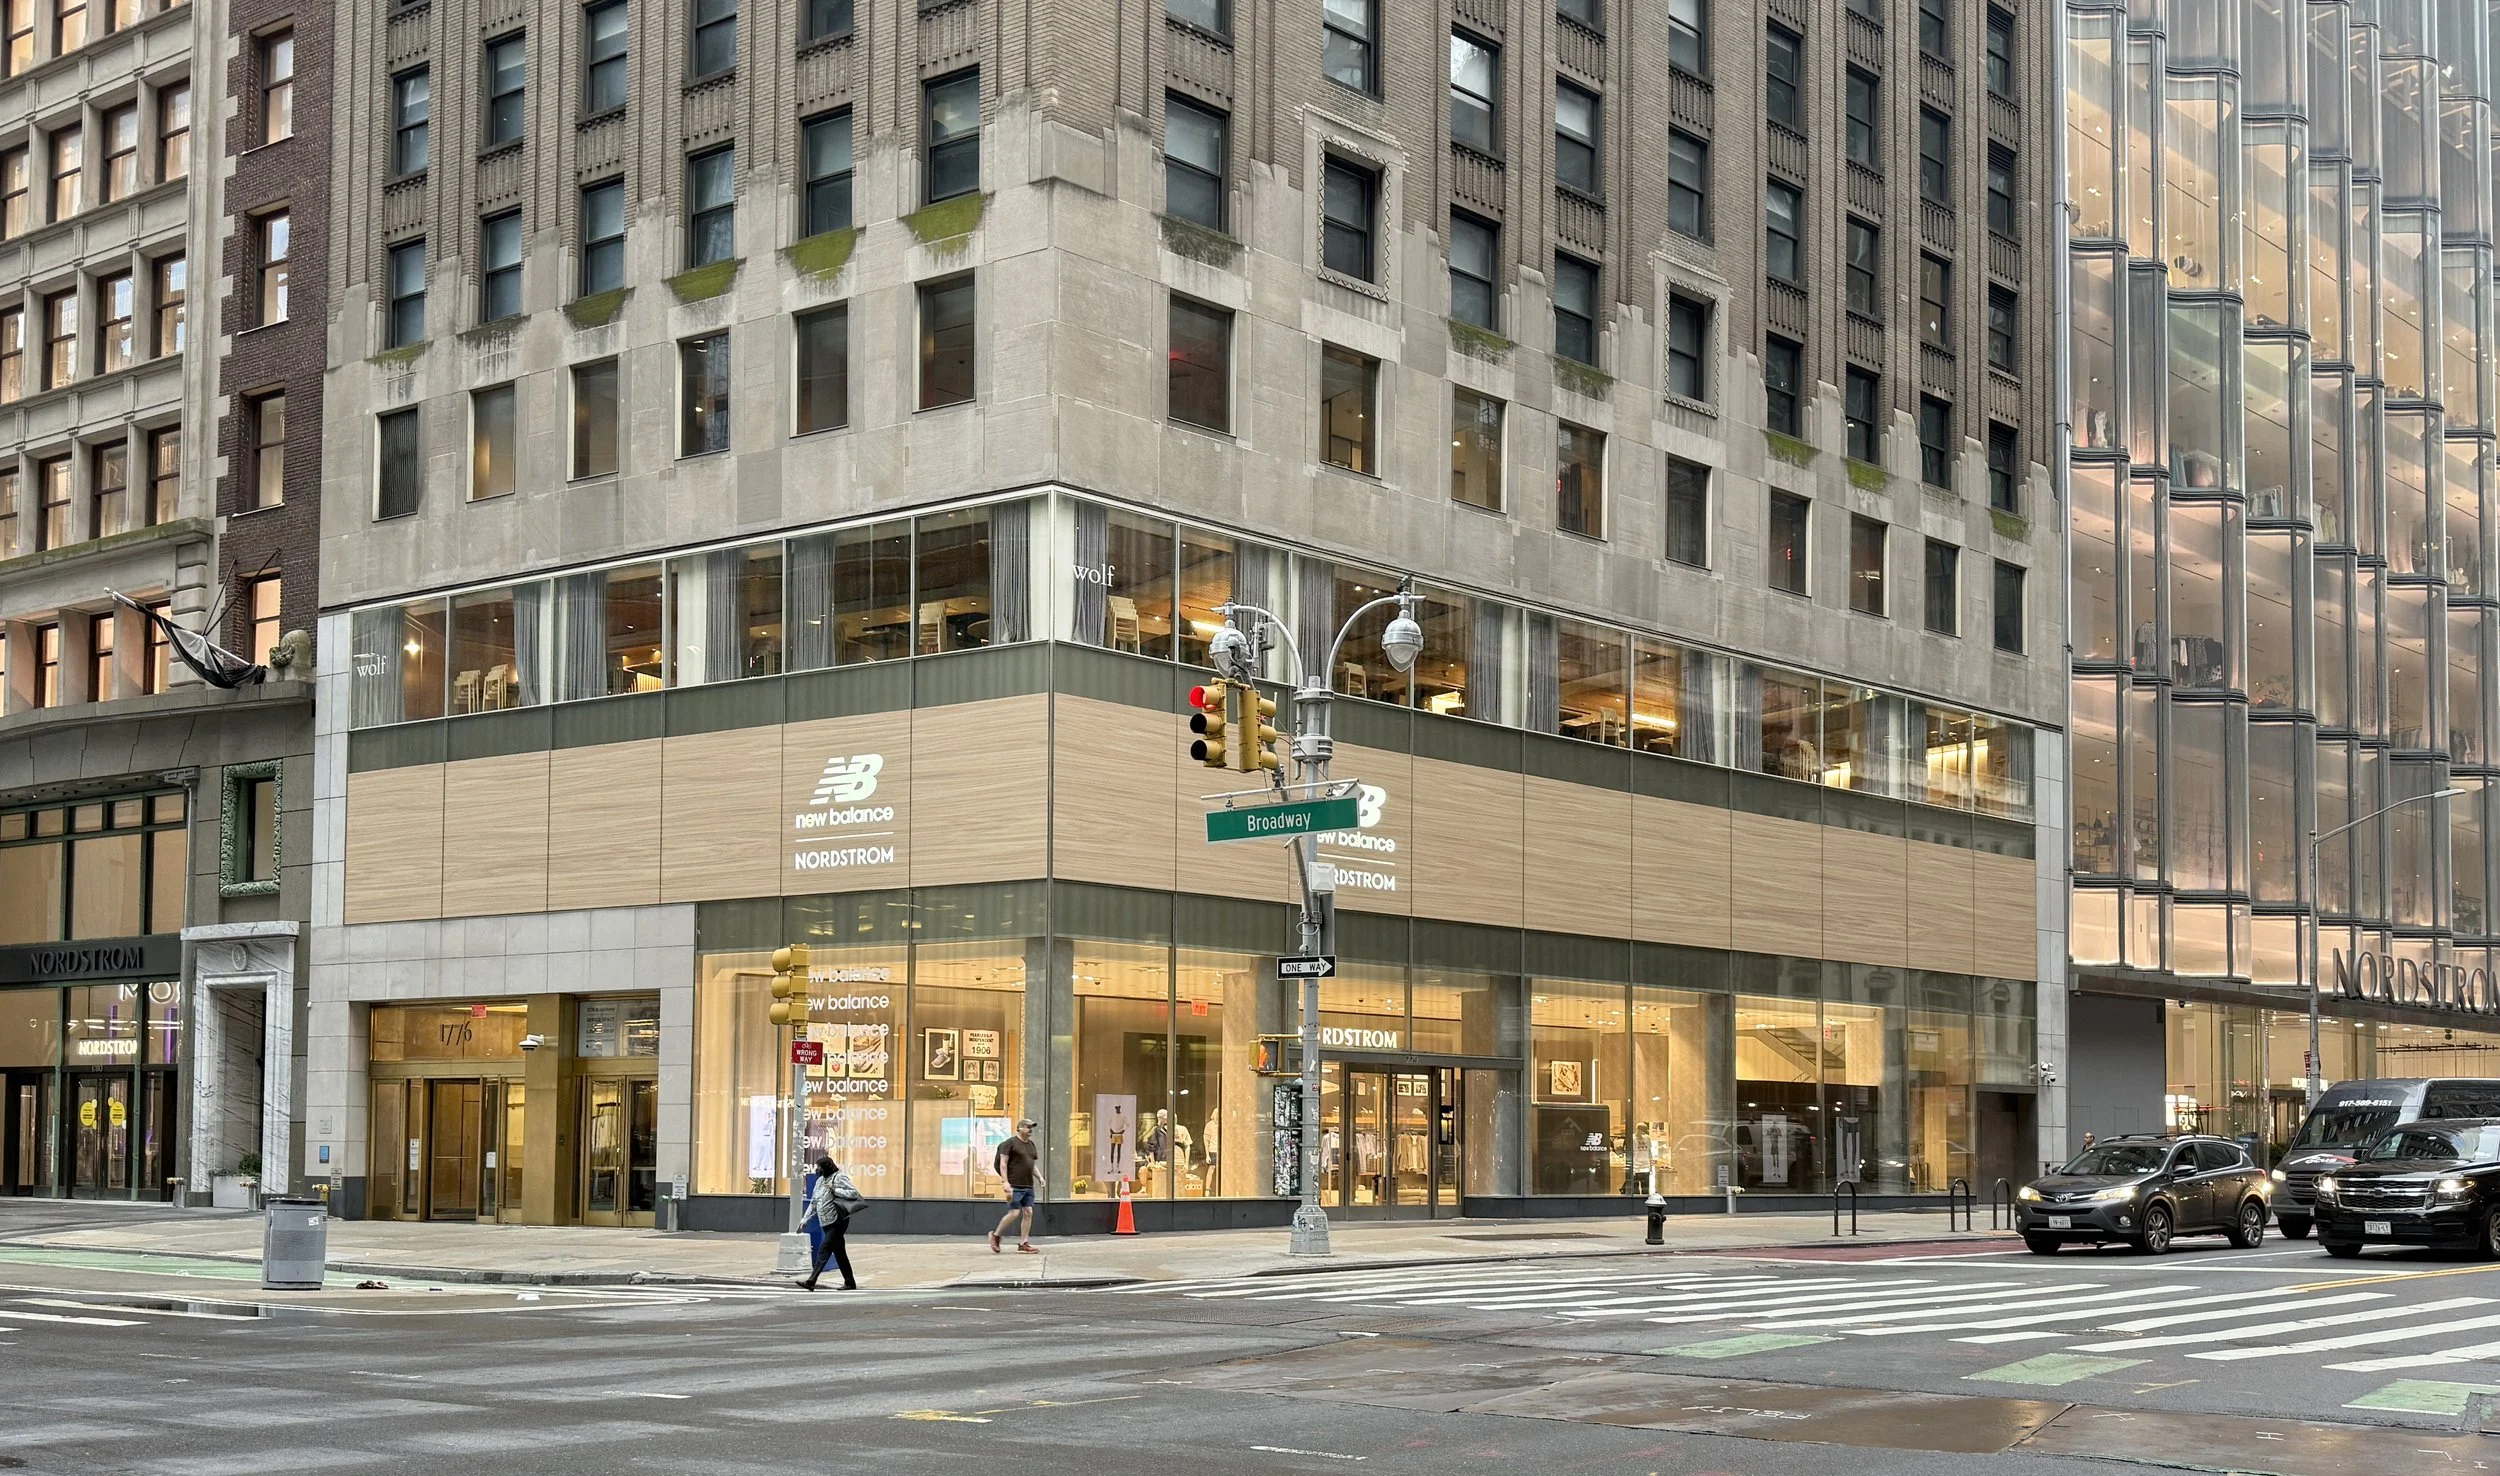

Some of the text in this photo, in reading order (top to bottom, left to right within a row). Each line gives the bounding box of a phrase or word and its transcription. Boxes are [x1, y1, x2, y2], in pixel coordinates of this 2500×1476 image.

[1073, 563, 1116, 587] wolf
[356, 655, 387, 677] wolf
[795, 806, 895, 829] new balance
[1247, 812, 1311, 832] Broadway
[1317, 831, 1396, 853] ew balance
[795, 845, 894, 870] NORDSTROM
[30, 946, 144, 975] NORDSTROM
[1285, 963, 1327, 972] ONE WAY
[828, 993, 890, 1010] balance
[440, 1020, 472, 1046] 1776
[796, 1049, 817, 1057] WRONG
[971, 1046, 991, 1055] 1906
[805, 1076, 888, 1093] ew balance
[803, 1104, 888, 1121] ew balance
[803, 1132, 887, 1149] ew balance
